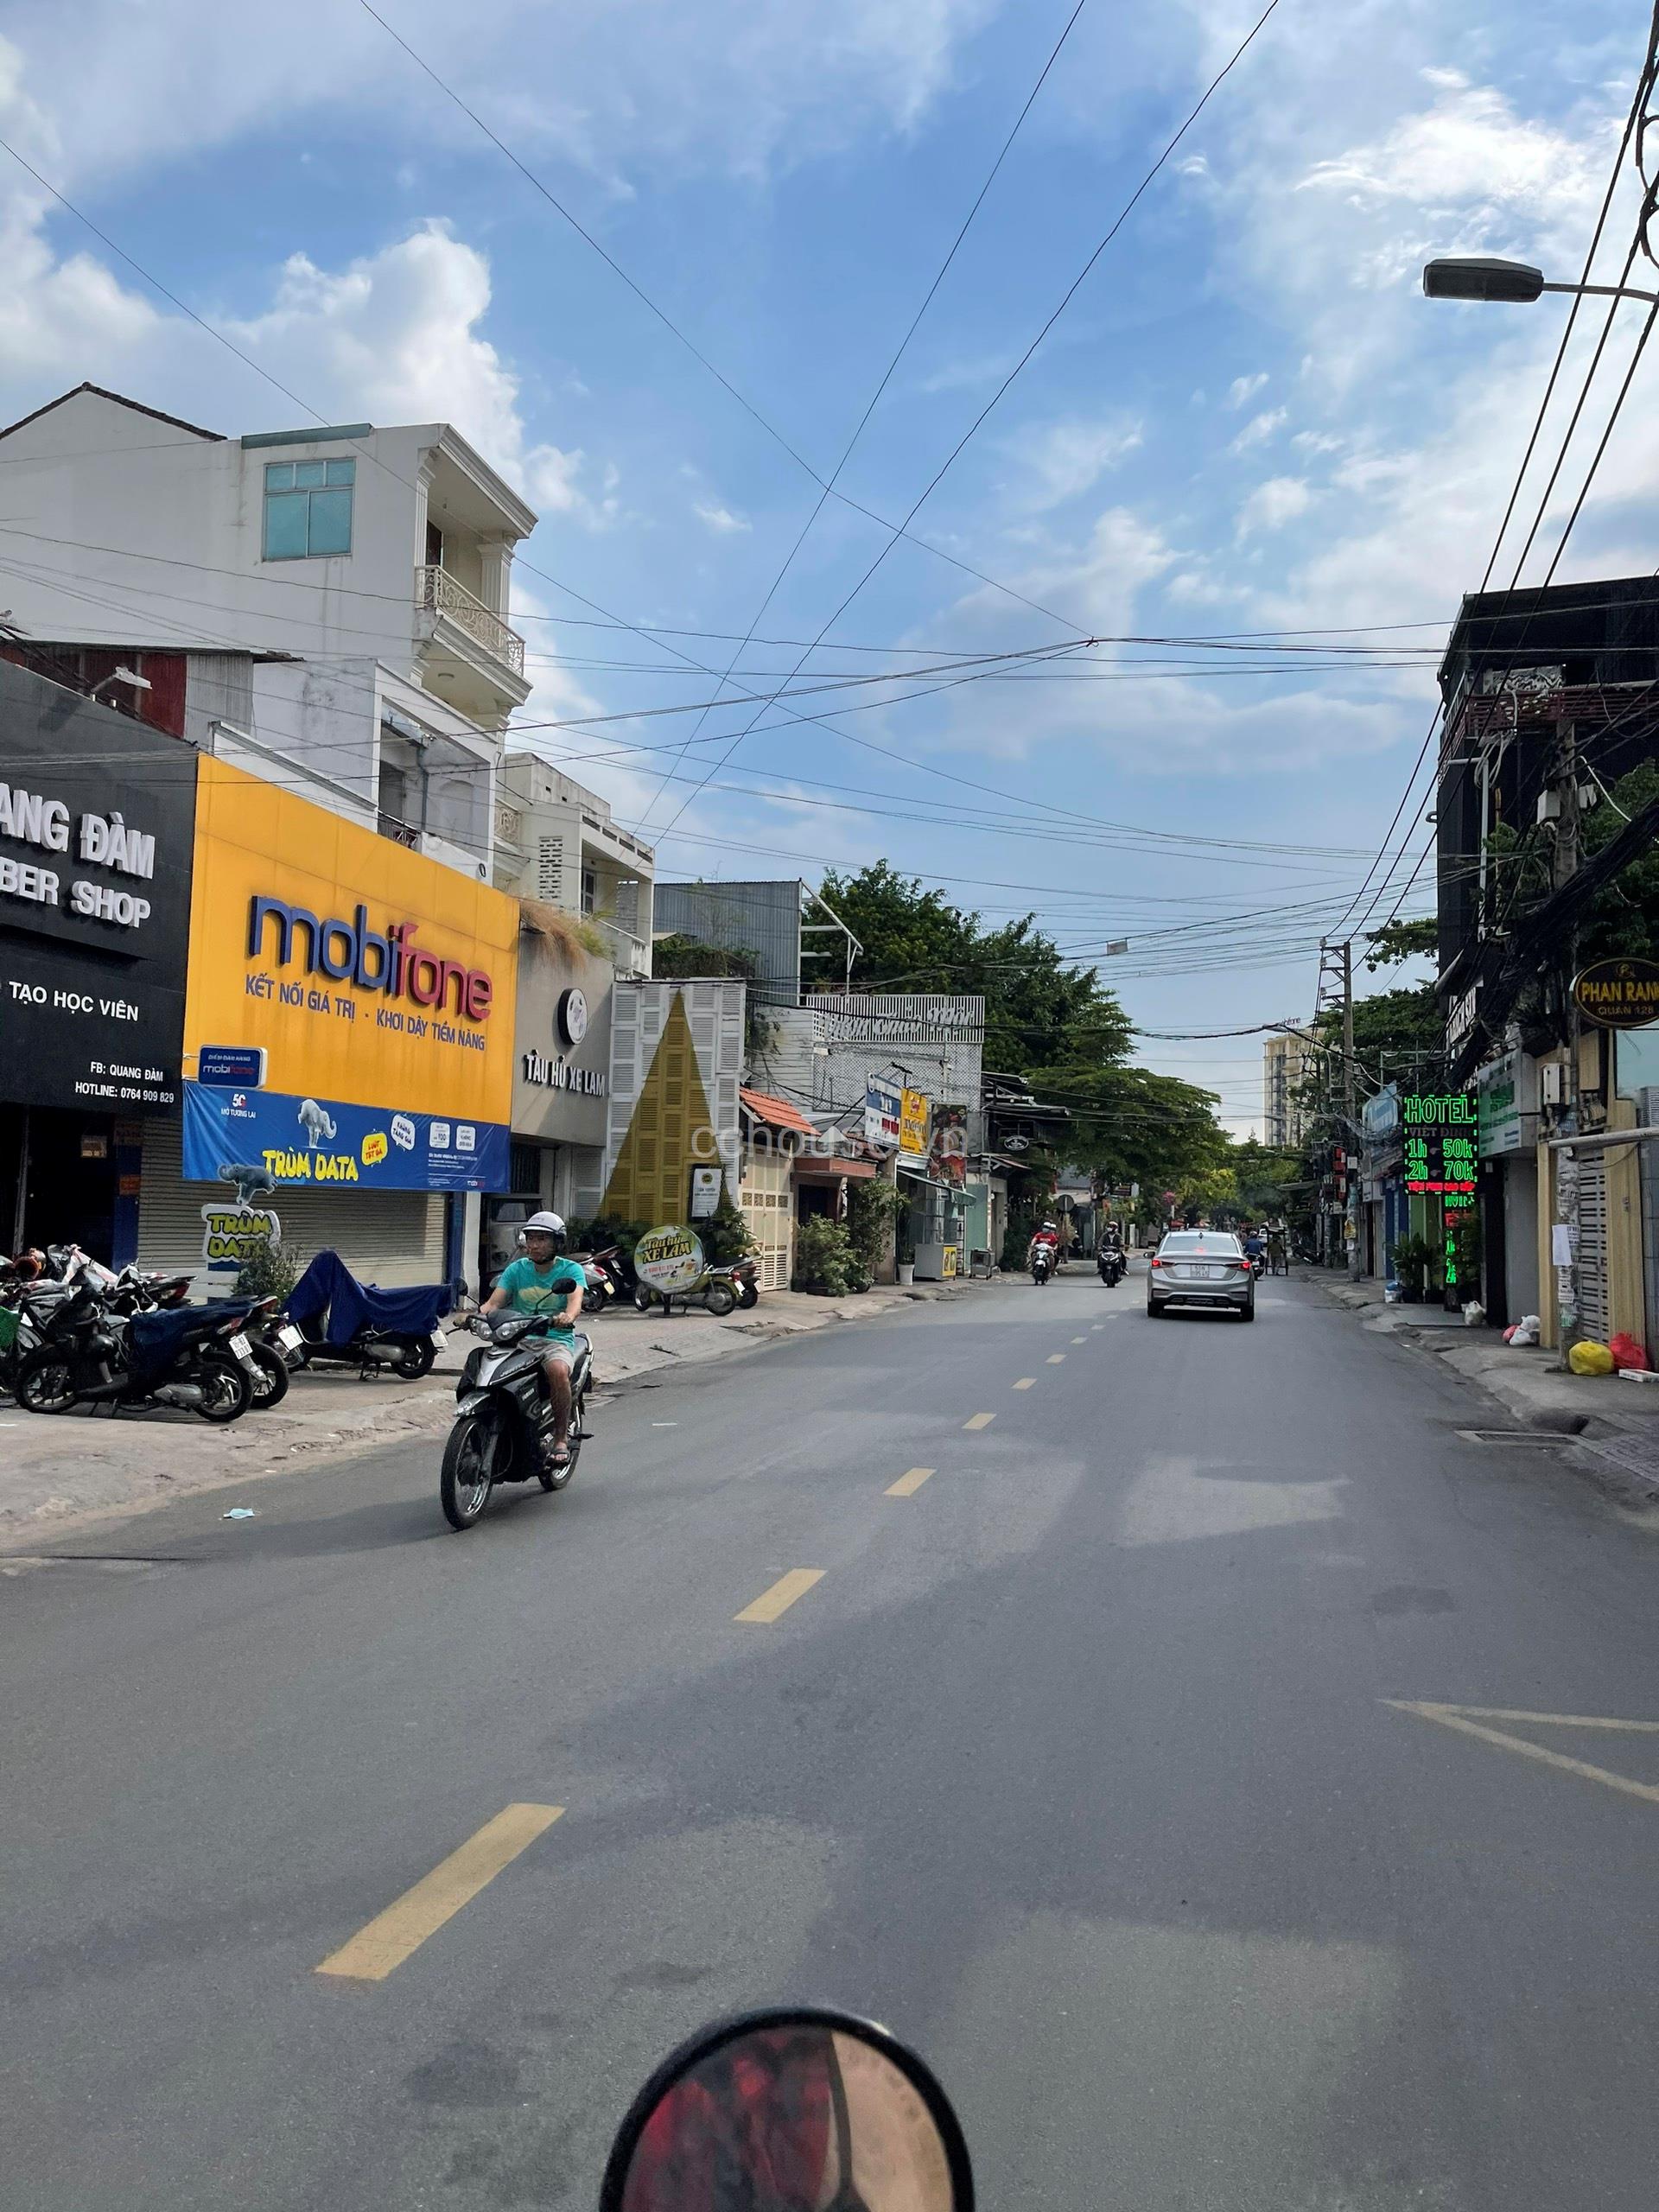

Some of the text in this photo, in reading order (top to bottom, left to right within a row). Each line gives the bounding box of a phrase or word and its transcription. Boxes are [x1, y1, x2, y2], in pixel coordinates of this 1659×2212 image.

[80, 812, 156, 880] ĐÀM
[0, 856, 151, 928] BER SHOP
[250, 896, 493, 1020] mobifone
[9, 981, 139, 1021] TẠO HỌC VIÊN
[1581, 981, 1621, 1001] PHAN
[245, 973, 275, 1000] KẾT
[279, 982, 303, 1007] NỐI
[308, 990, 330, 1014] GIÁ
[334, 997, 355, 1024] TRỊ
[377, 1008, 404, 1031] KHƠI
[407, 1016, 428, 1040] DẬY
[90, 1061, 163, 1082] FB: QUANG ĐÀM
[569, 1066, 582, 1091] XE
[584, 1071, 605, 1096] LAM
[75, 1081, 175, 1103] HOTLINE: 0764 909 829
[1407, 1097, 1474, 1123] HOTEL
[1408, 1138, 1427, 1158] 1h
[1442, 1138, 1473, 1158] 50k
[262, 1147, 359, 1182] TRÙM DATA
[1408, 1160, 1474, 1180] 2h 70k
[207, 1211, 273, 1236] TRÙM
[207, 1236, 257, 1259] DAT
[643, 1241, 691, 1263] XE LAM
